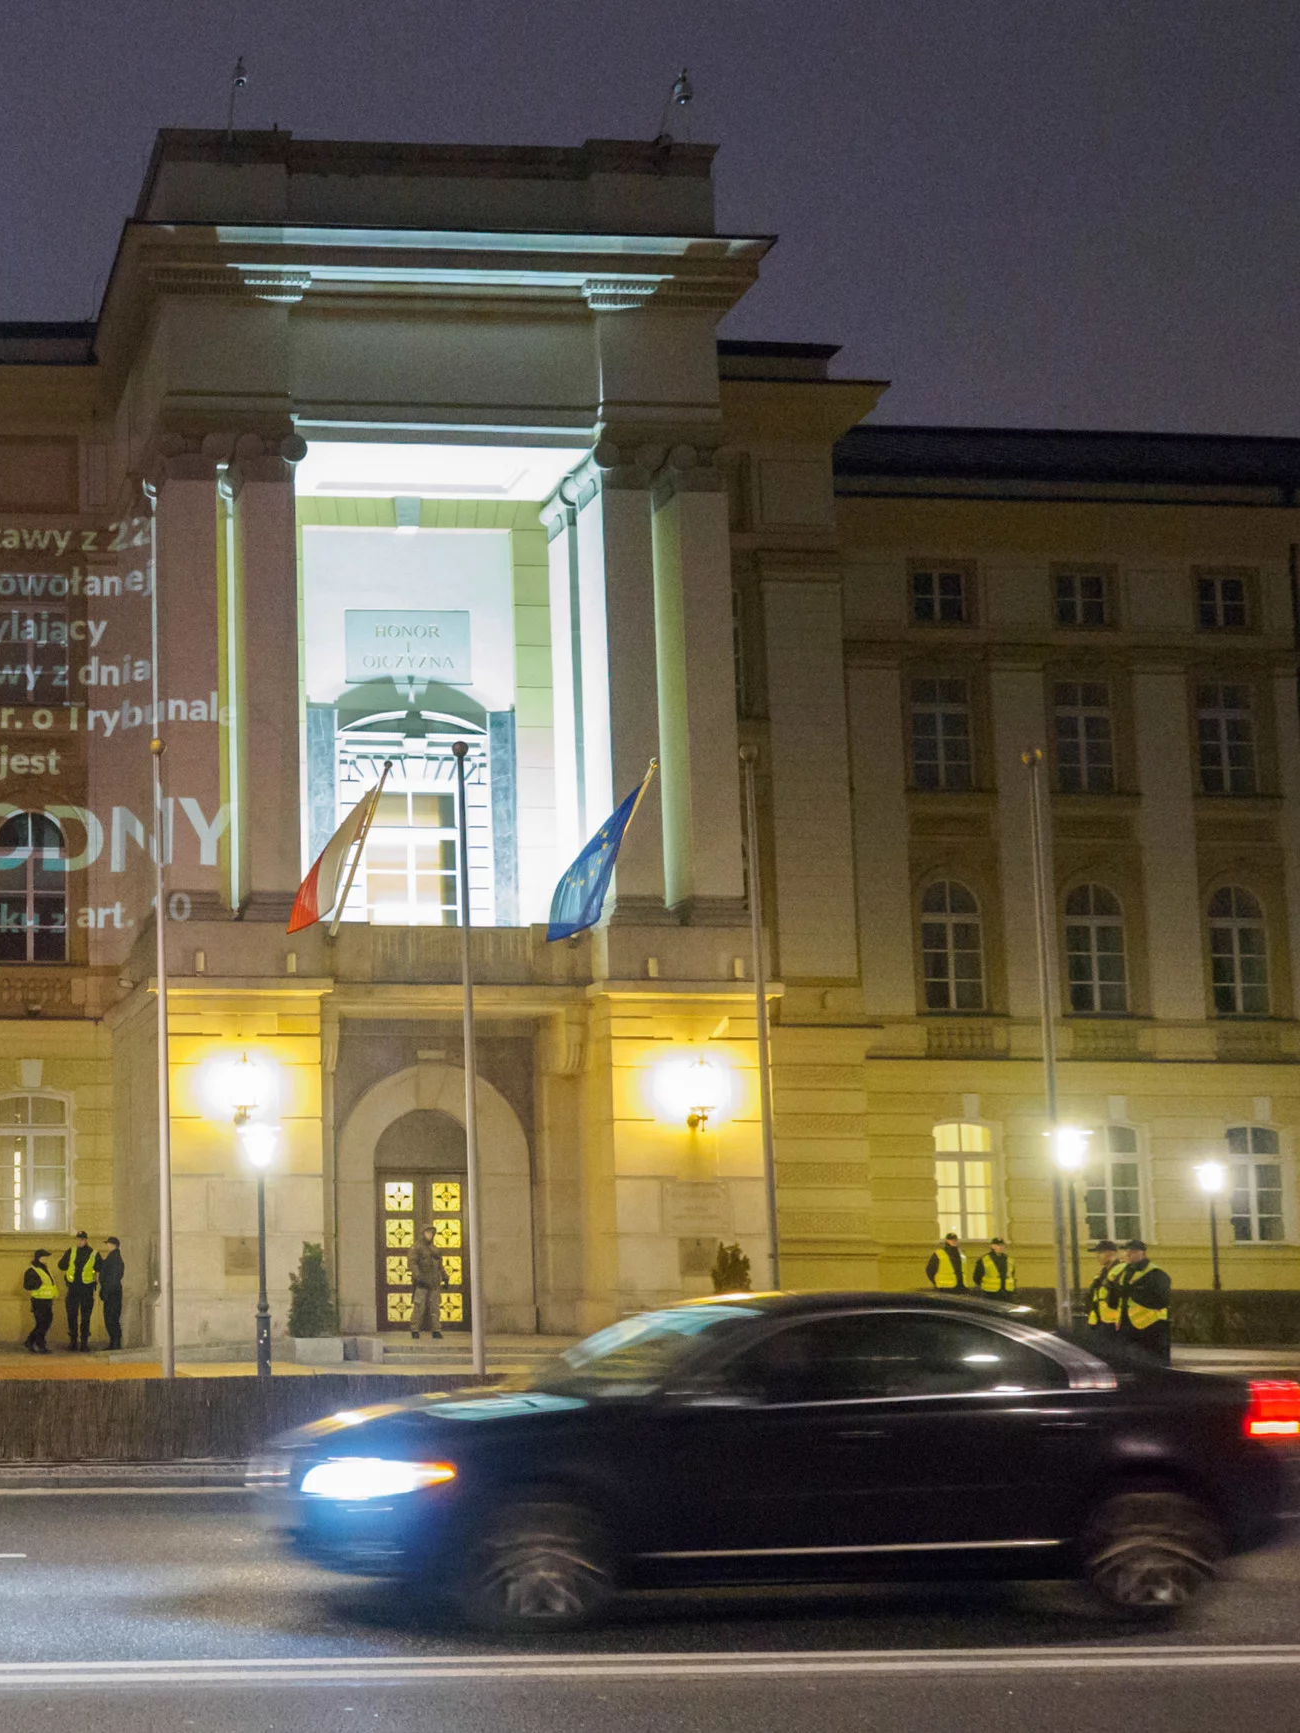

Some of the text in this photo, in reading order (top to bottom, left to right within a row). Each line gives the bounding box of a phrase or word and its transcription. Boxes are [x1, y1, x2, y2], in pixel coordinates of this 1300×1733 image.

[81, 531, 98, 551] z
[108, 516, 153, 551] 22
[375, 624, 440, 638] HONOR
[52, 664, 69, 686] z
[78, 654, 152, 686] dnia
[362, 654, 455, 669] OJCZYZNA
[0, 708, 22, 729] r.
[32, 708, 54, 730] o
[76, 901, 135, 929] art.
